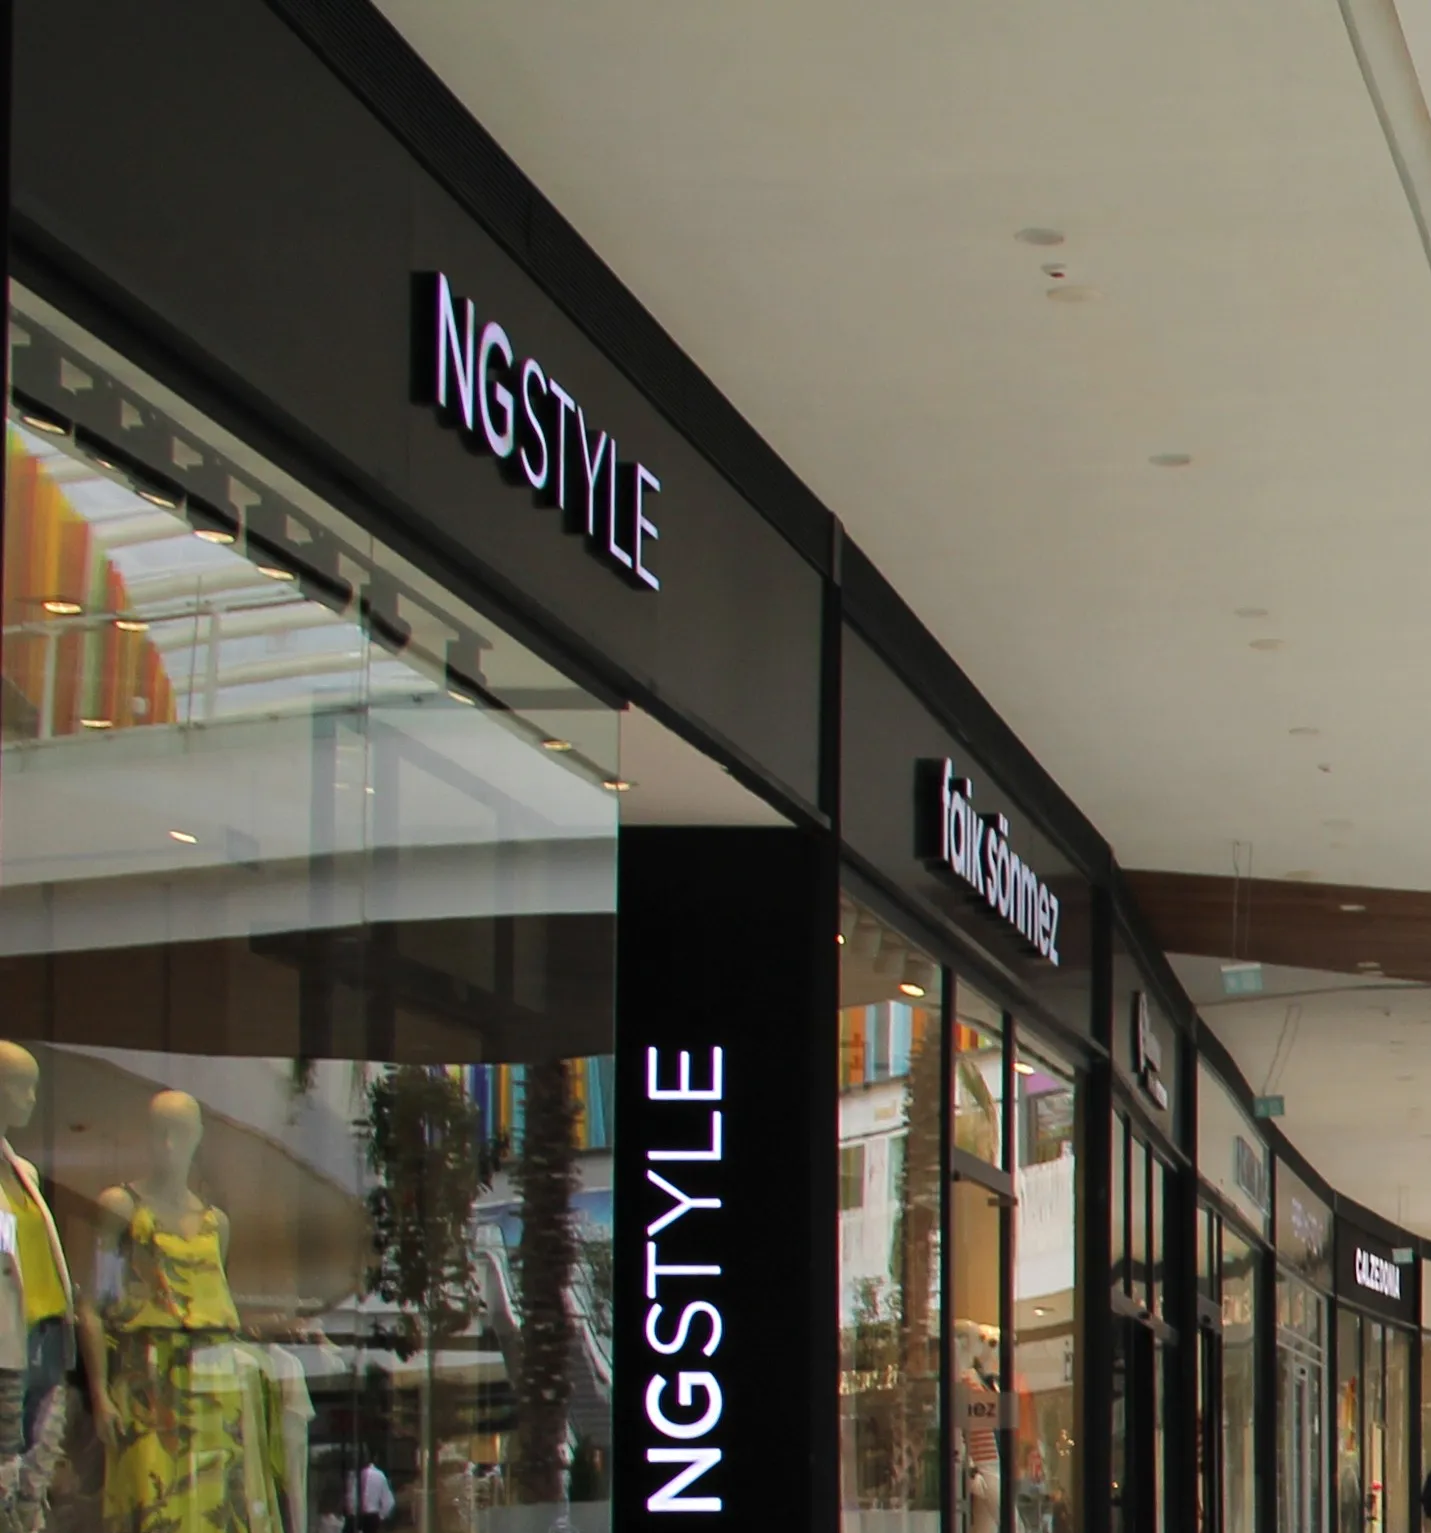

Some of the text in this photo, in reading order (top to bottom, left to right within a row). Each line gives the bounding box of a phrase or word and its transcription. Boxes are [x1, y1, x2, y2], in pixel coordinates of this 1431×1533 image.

[437, 270, 661, 592] NGSTYLE
[941, 756, 1060, 967] faik sönmez
[645, 1045, 724, 1513] NGSTYLE
